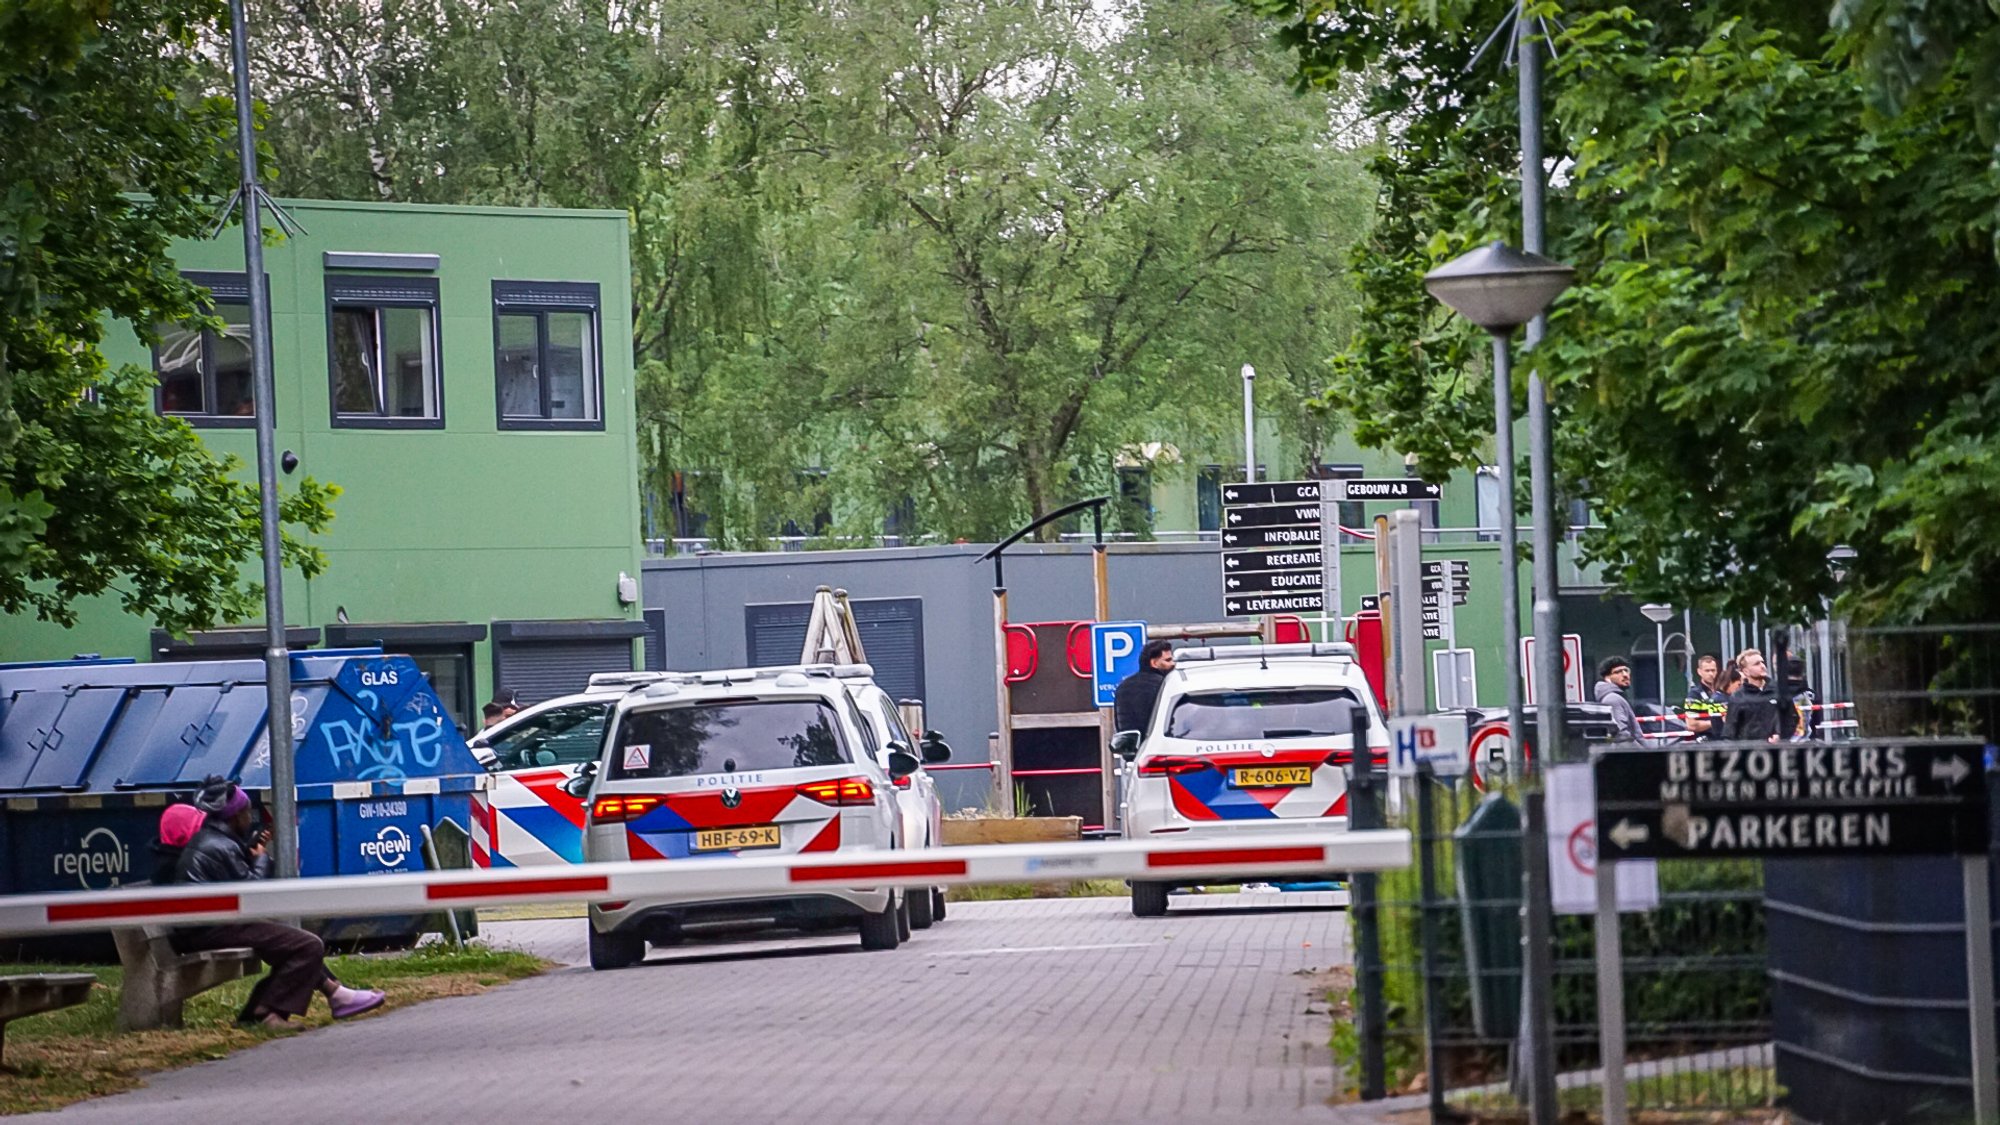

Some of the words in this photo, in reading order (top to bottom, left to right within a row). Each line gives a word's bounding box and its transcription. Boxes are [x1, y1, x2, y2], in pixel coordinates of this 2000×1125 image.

[1297, 486, 1319, 497] GCA
[1347, 484, 1390, 495] GEBOUW
[1295, 508, 1320, 519] VWN
[1264, 530, 1320, 542] INFOBALIE
[1266, 552, 1321, 566] RECREATIE
[1271, 574, 1322, 587] EDUCATIE
[1246, 597, 1322, 611] LEVERANCIERS
[1104, 631, 1134, 673] P
[361, 671, 398, 686] GLAS
[1196, 743, 1254, 753] POLITIE
[1668, 749, 1907, 782] BEZOEKERS
[697, 773, 763, 787] POLITIE
[1240, 769, 1307, 783] R-606-VZ
[1659, 778, 1756, 801] MELDEN
[1809, 775, 1917, 798] RECEPTIE
[701, 829, 775, 847] HBF-69-K
[1686, 813, 1890, 849] PARKEREN
[360, 835, 411, 856] renewi
[53, 843, 130, 875] renewi
